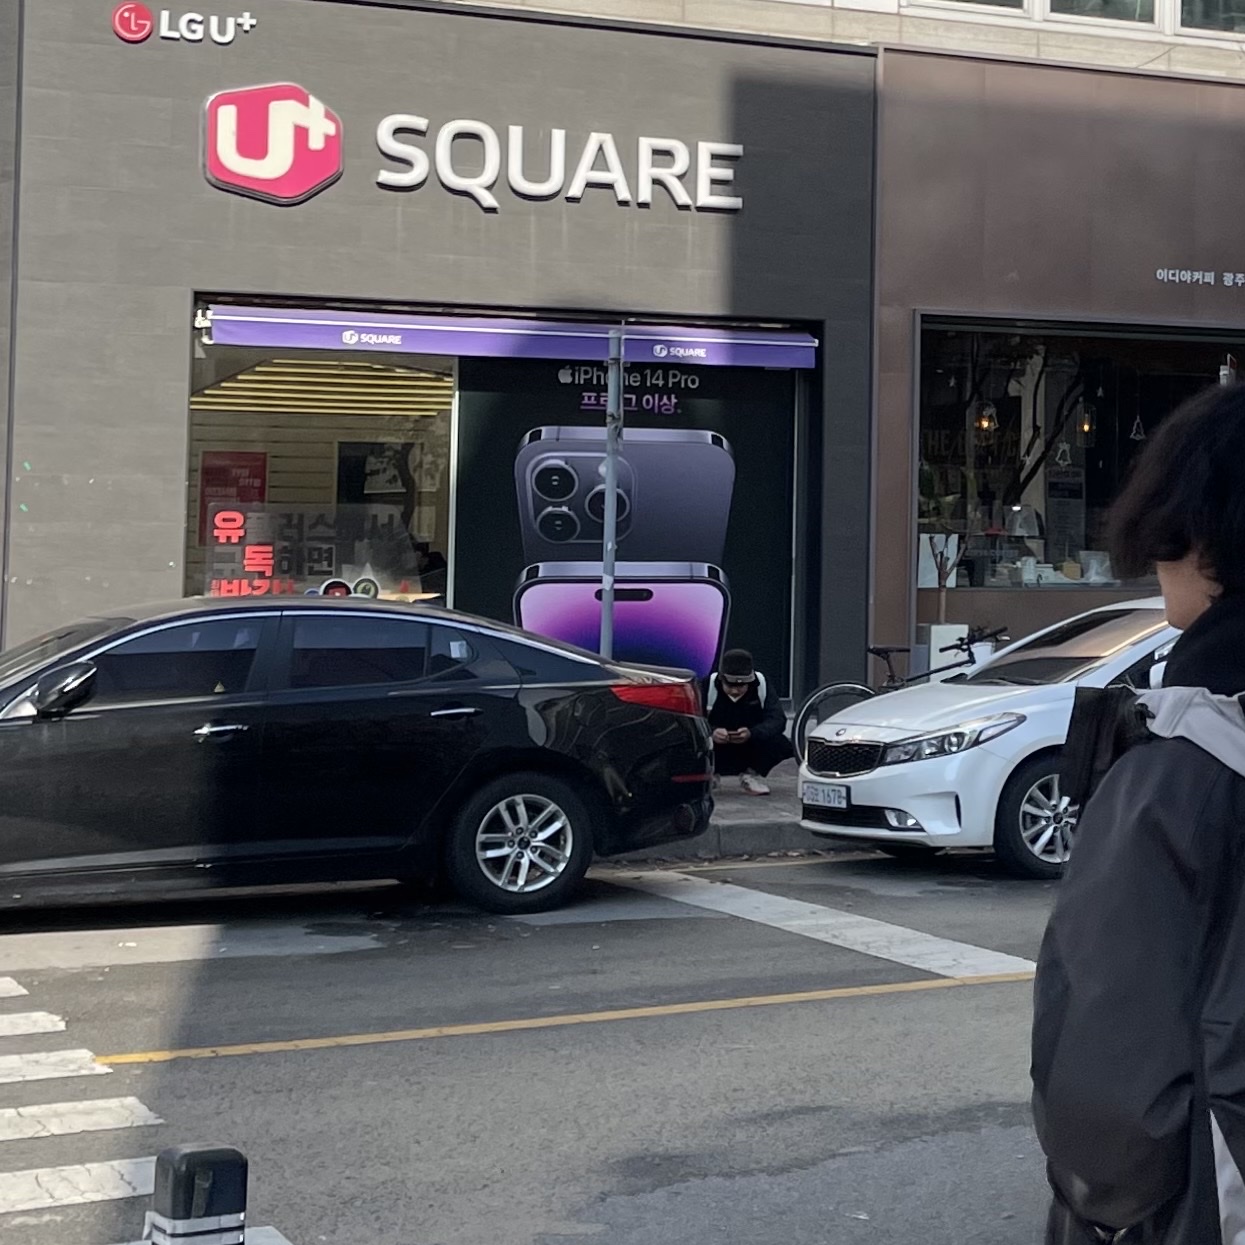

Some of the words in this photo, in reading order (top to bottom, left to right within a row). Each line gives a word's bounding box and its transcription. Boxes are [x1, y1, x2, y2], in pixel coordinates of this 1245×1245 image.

[375, 113, 744, 214] SQUARE
[1156, 268, 1215, 286] 이디야커피
[360, 333, 402, 345] SQUARE
[669, 347, 707, 358] SQUARE
[574, 366, 642, 387] iPhne
[644, 369, 665, 388] 14
[668, 370, 701, 389] Pro
